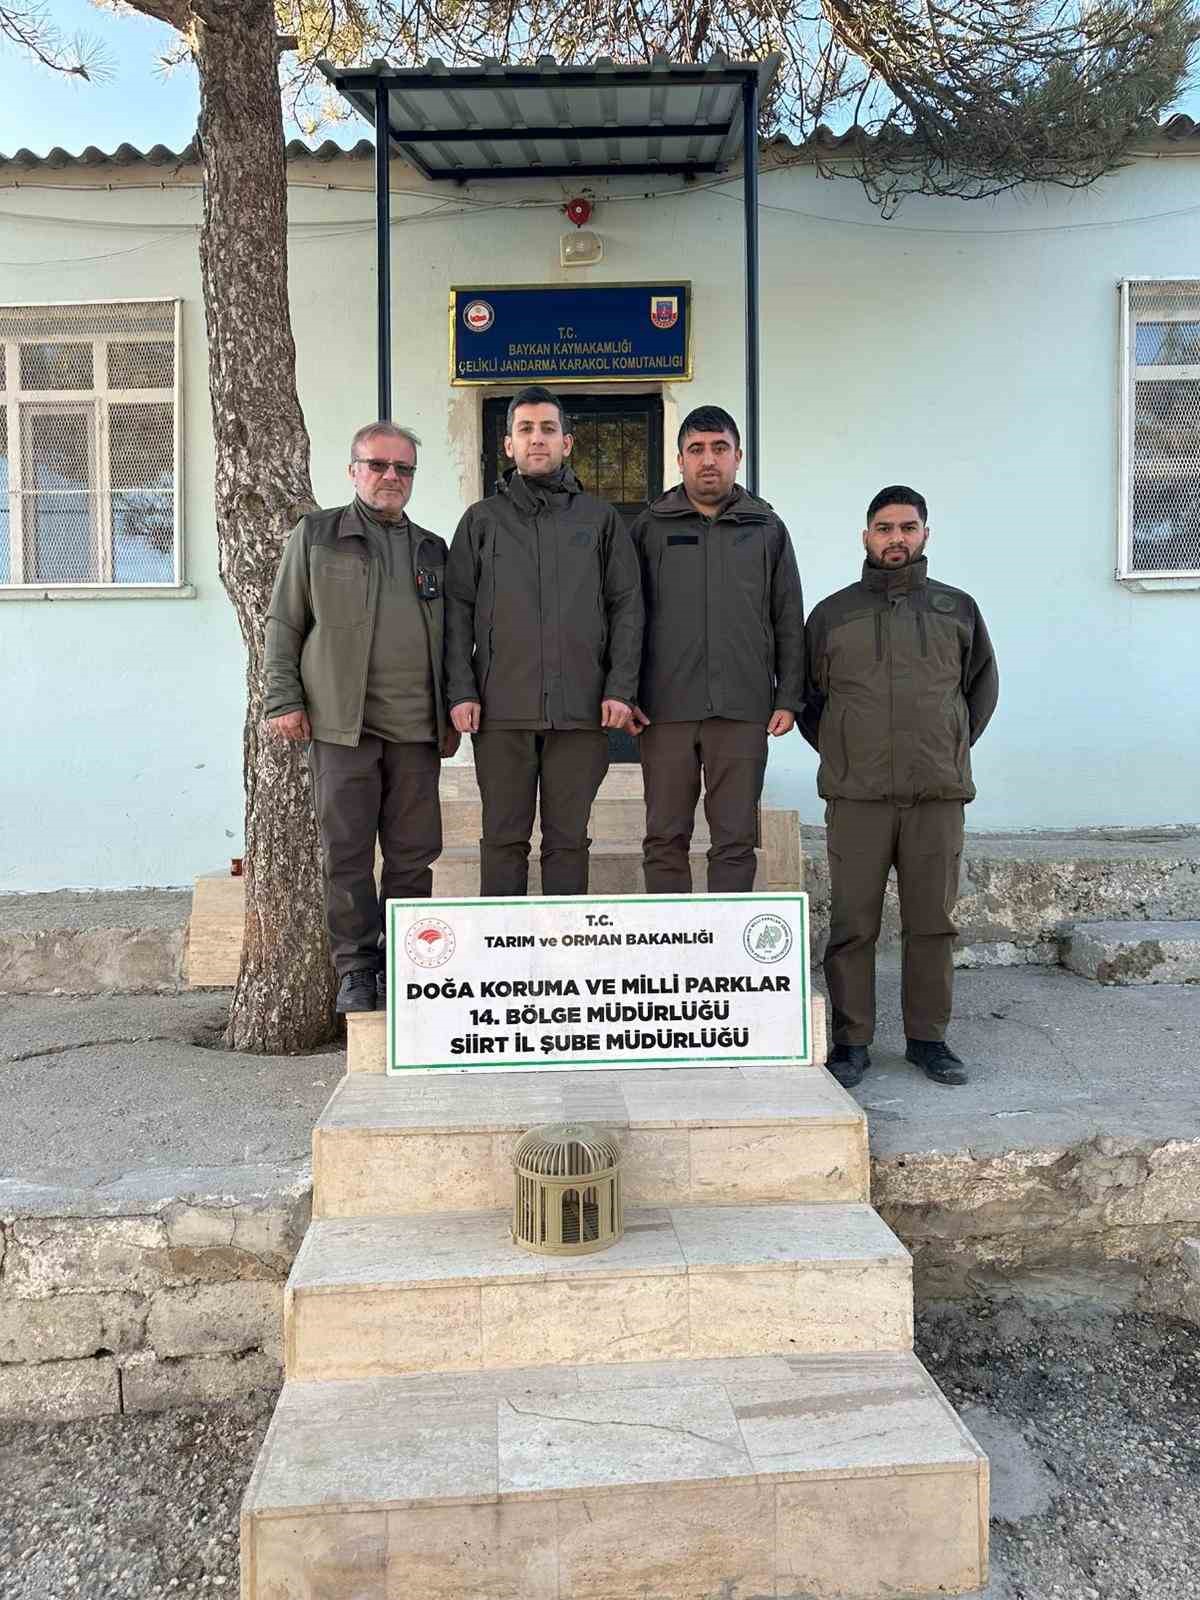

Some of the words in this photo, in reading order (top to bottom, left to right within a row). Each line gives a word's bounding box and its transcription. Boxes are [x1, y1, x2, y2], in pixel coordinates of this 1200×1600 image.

[557, 327, 578, 339] T.C.
[508, 343, 550, 356] BAYKAN
[553, 339, 633, 354] KAYMAKAMLIĞI
[458, 356, 498, 375] ÇELİKLİ
[500, 358, 557, 372] JANDARMA
[559, 357, 611, 370] KARAKOL
[585, 914, 614, 927] T.C.
[484, 935, 535, 948] TARIM
[539, 937, 558, 947] ve
[561, 933, 622, 947] ORMAN
[625, 929, 714, 946] BAKANLIĞI
[406, 977, 475, 1000] DOĞA
[480, 980, 580, 998] KORUMA
[585, 978, 616, 996] VE
[621, 974, 679, 995] MİLLİ
[685, 975, 791, 993] PARKLAR
[469, 1009, 500, 1026] 14.
[505, 1004, 581, 1026] BÖLGE
[587, 999, 730, 1024] MÜDÜRLÜĞÜ
[450, 1033, 509, 1055] SİİRT
[514, 1032, 535, 1053] İL
[540, 1034, 601, 1055] ŞUBE
[606, 1026, 749, 1050] MÜDÜRLÜĞÜ
